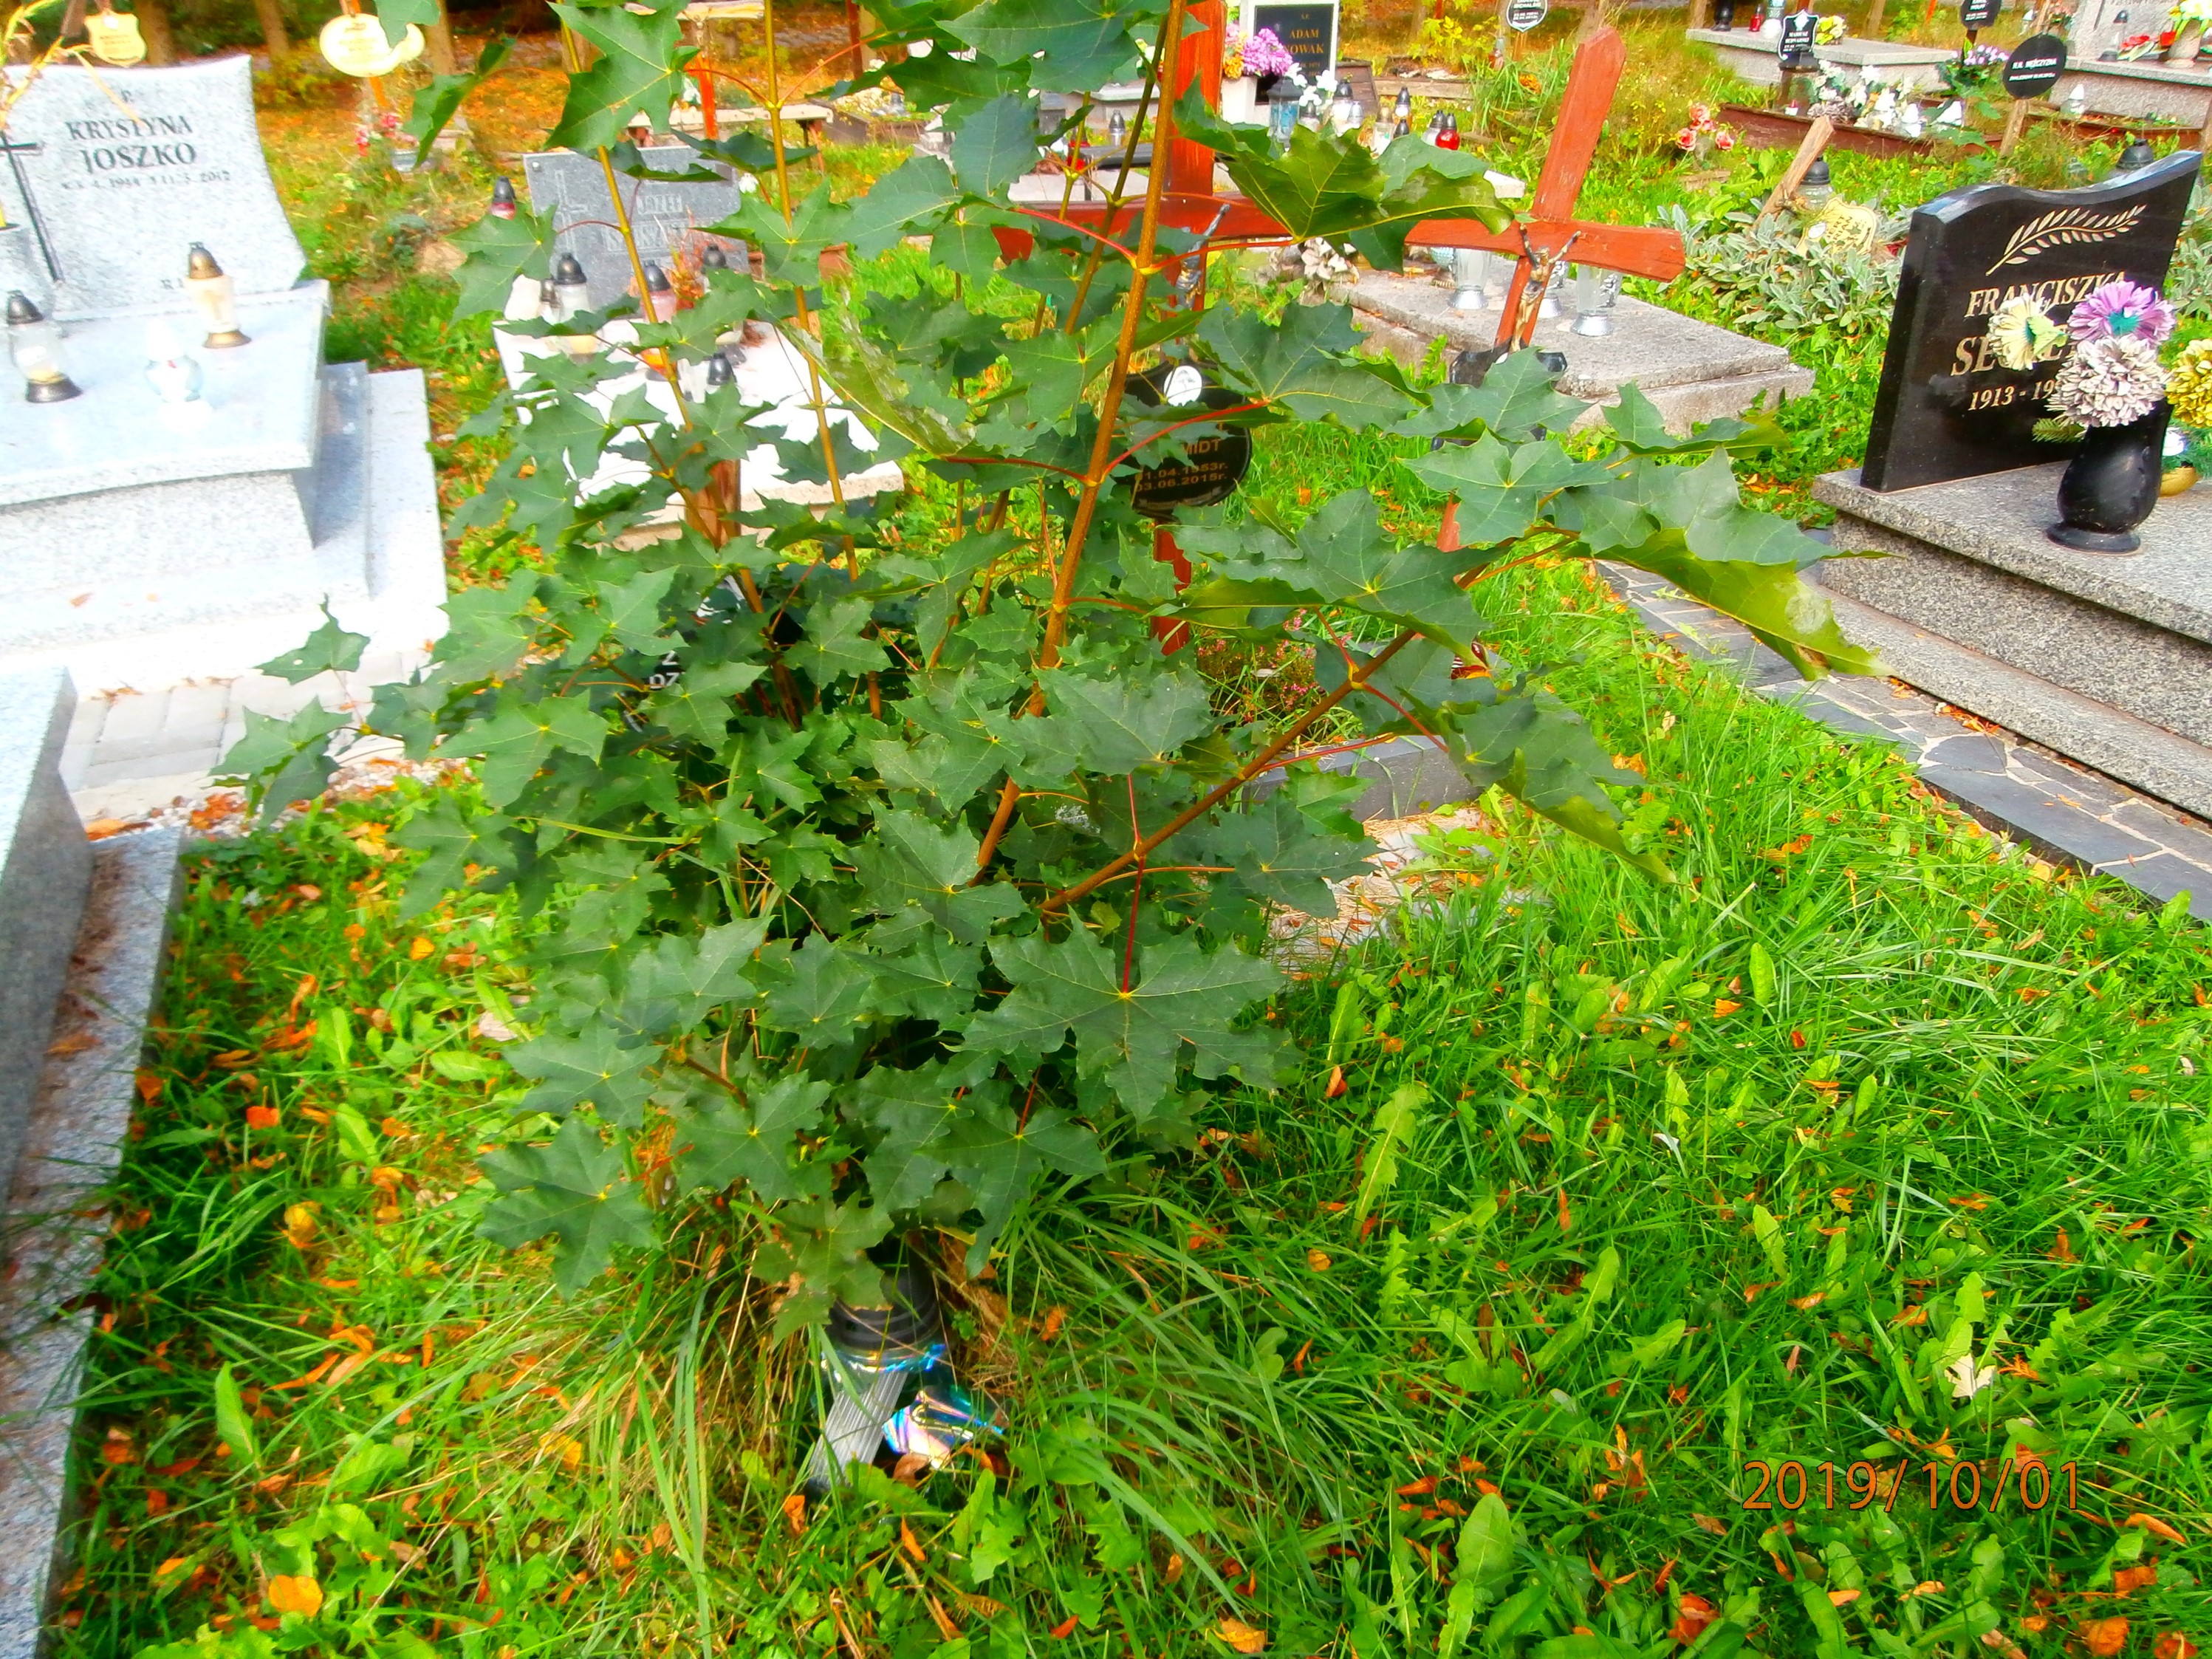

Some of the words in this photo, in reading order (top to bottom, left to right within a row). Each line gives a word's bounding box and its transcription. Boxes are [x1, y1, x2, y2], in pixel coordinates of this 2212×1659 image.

[1290, 29, 1320, 38] ADAM
[1284, 43, 1324, 54] NOWAK
[64, 115, 194, 141] KRYSTYNA
[80, 142, 197, 174] JOSZKO
[1968, 385, 2016, 411] 1913
[1183, 438, 1222, 456] MIDT
[1141, 461, 1228, 481] 1.04.1953r.
